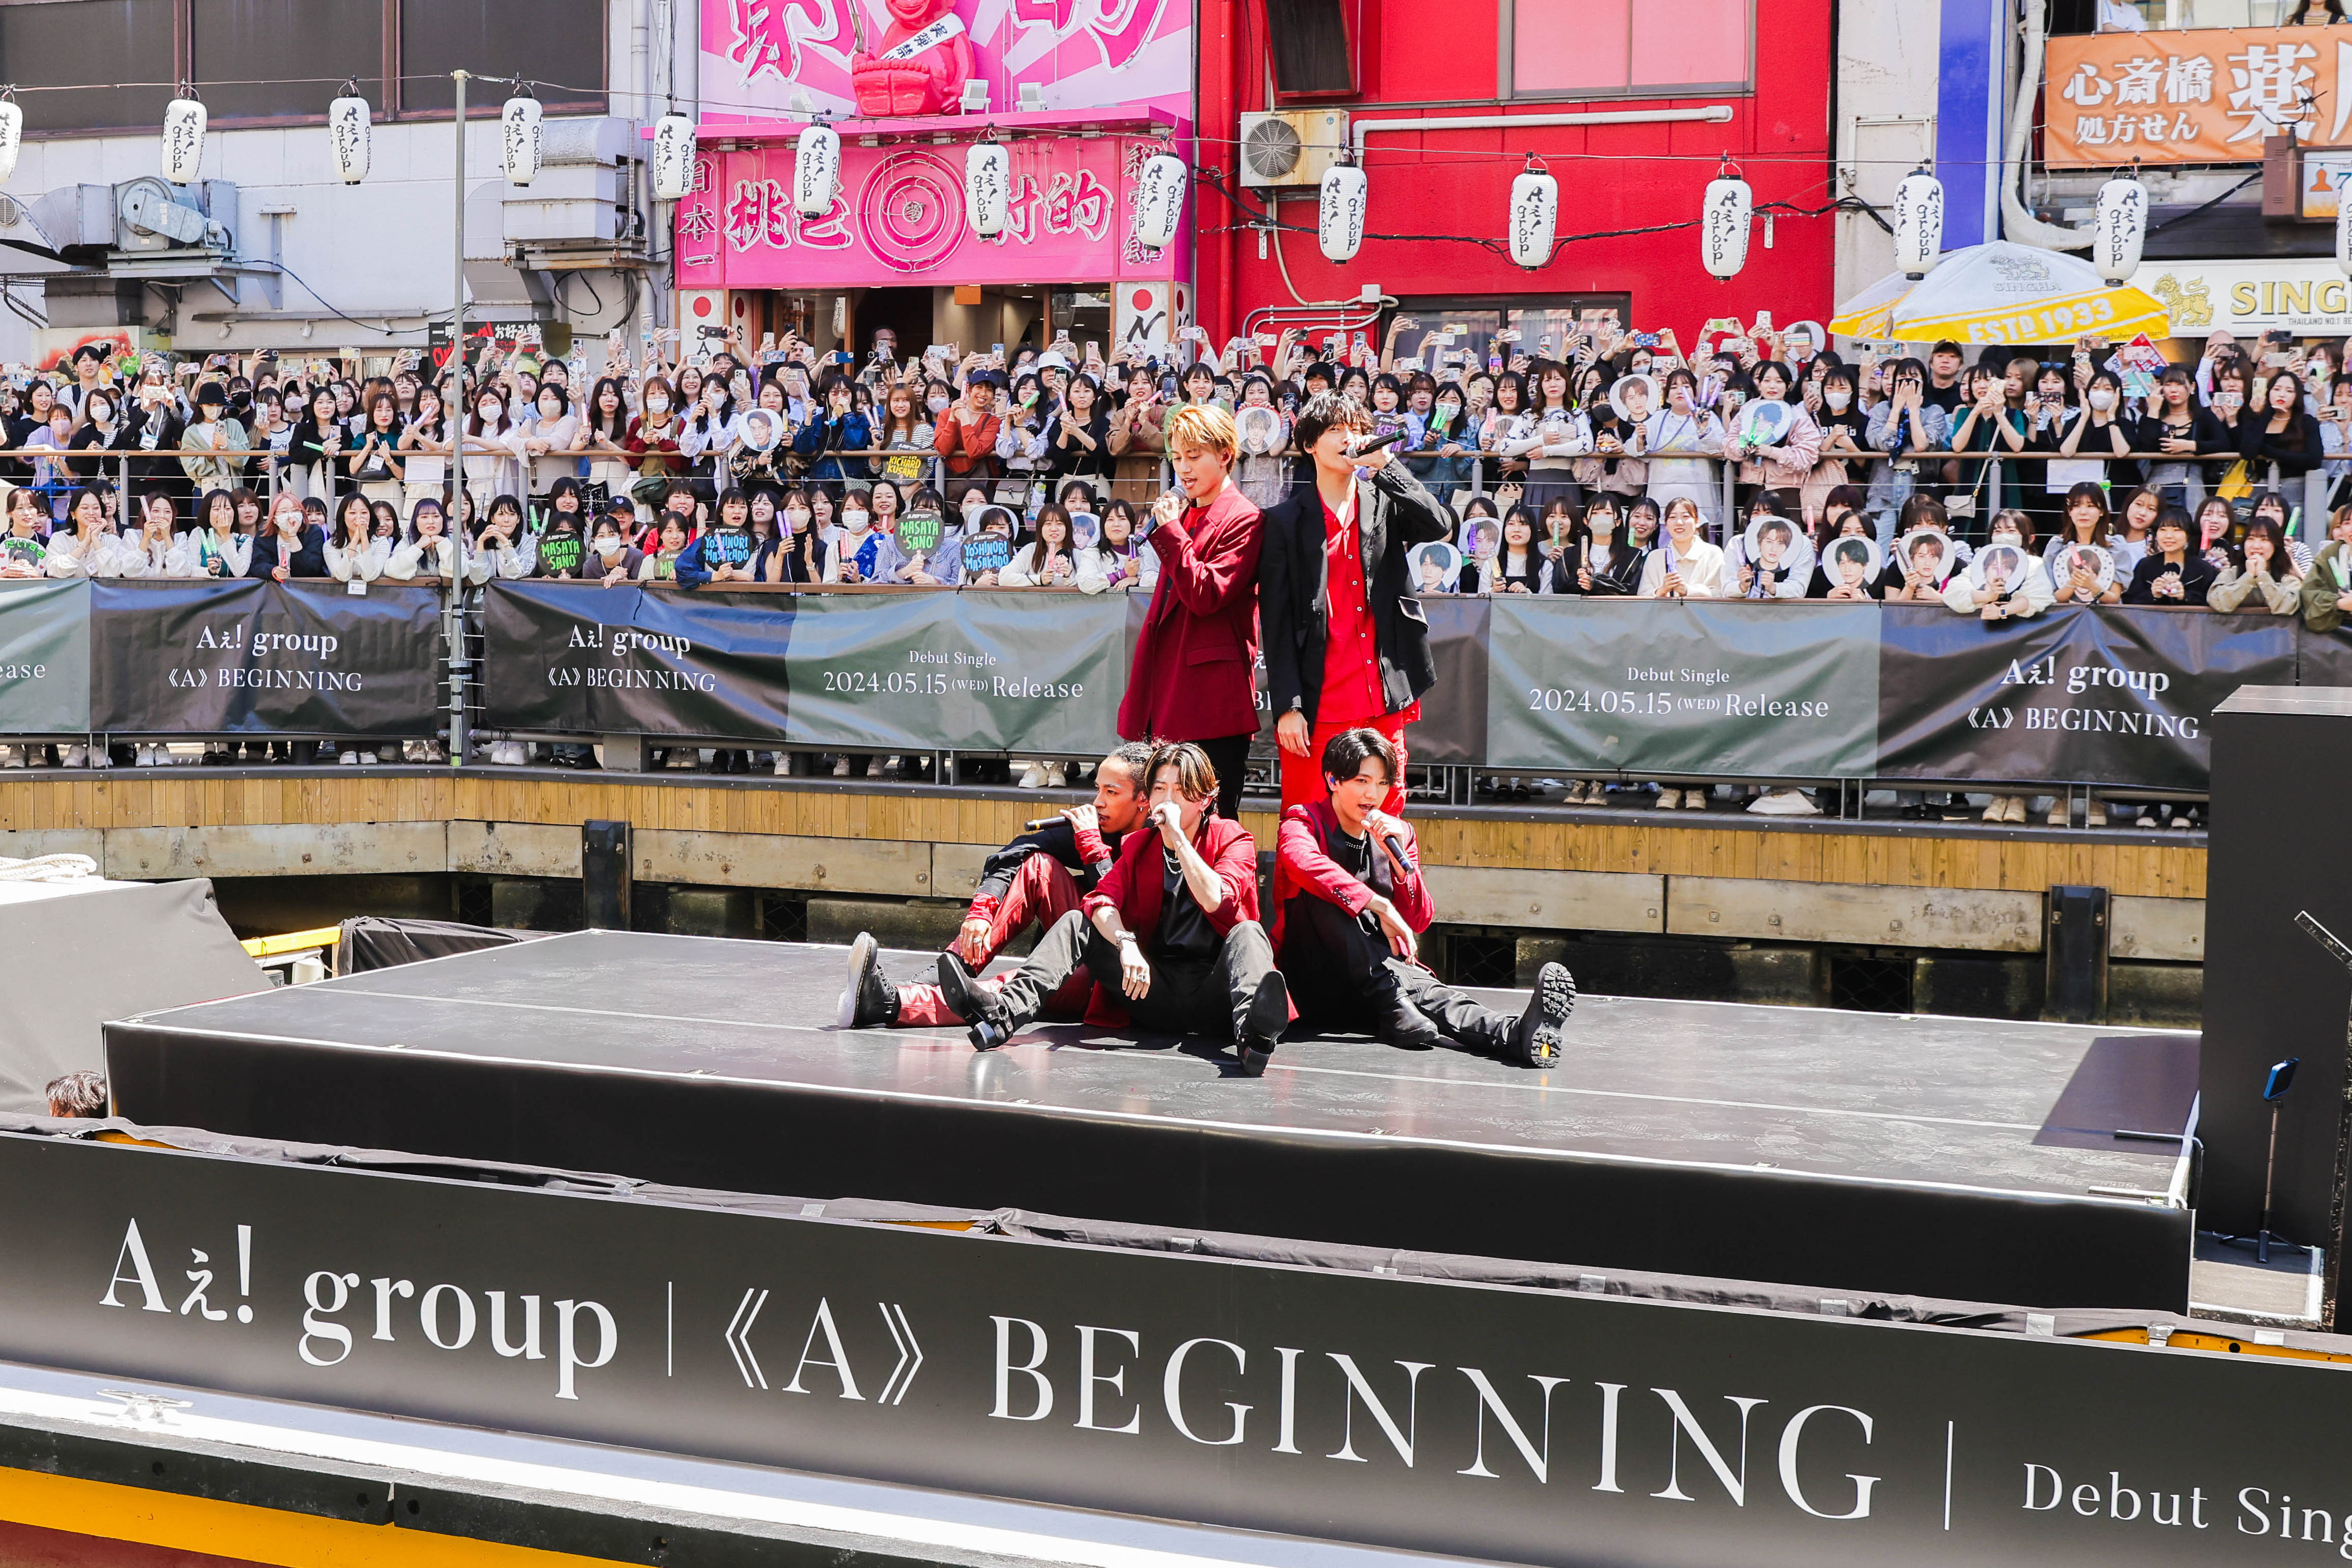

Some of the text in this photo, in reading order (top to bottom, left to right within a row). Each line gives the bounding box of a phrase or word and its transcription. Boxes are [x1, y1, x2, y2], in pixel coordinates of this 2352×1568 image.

[2076, 112, 2199, 145] 処方せん
[173, 126, 182, 173] group
[336, 125, 350, 173] group
[504, 125, 516, 173] group
[681, 144, 689, 192] group
[802, 152, 812, 202] group
[974, 175, 988, 226] group
[1138, 182, 1146, 233] group
[1163, 185, 1177, 237] group
[1320, 196, 1329, 248] group
[1348, 198, 1357, 251] group
[1518, 205, 1530, 257] group
[1711, 210, 1723, 265] group
[1918, 205, 1930, 262] group
[2110, 209, 2122, 267] group
[1993, 282, 2062, 292] SINGHA
[2230, 281, 2352, 315] SING
[2040, 298, 2114, 334] 1933
[2288, 317, 2322, 326] THAILAND
[900, 520, 939, 536] MASAYA
[906, 535, 934, 550] SANO
[541, 540, 580, 557] MASAYA
[549, 554, 576, 570] SANO
[964, 541, 1008, 557] YOSHINORI
[965, 554, 1009, 572] MASAKADO
[253, 633, 337, 660] group
[612, 633, 690, 660] group
[910, 651, 996, 668] Debut Single
[218, 668, 362, 691] BEGINNING
[587, 668, 715, 691] BEGINNING
[993, 676, 1083, 697] Release
[1628, 667, 1729, 686] Debut Single
[2067, 666, 2169, 700] group
[1725, 693, 1829, 717] Release
[2026, 708, 2198, 739] BEGINNING
[299, 1271, 617, 1400] group
[988, 1314, 1882, 1521] BEGINNING
[2022, 1463, 2209, 1529] Debut
